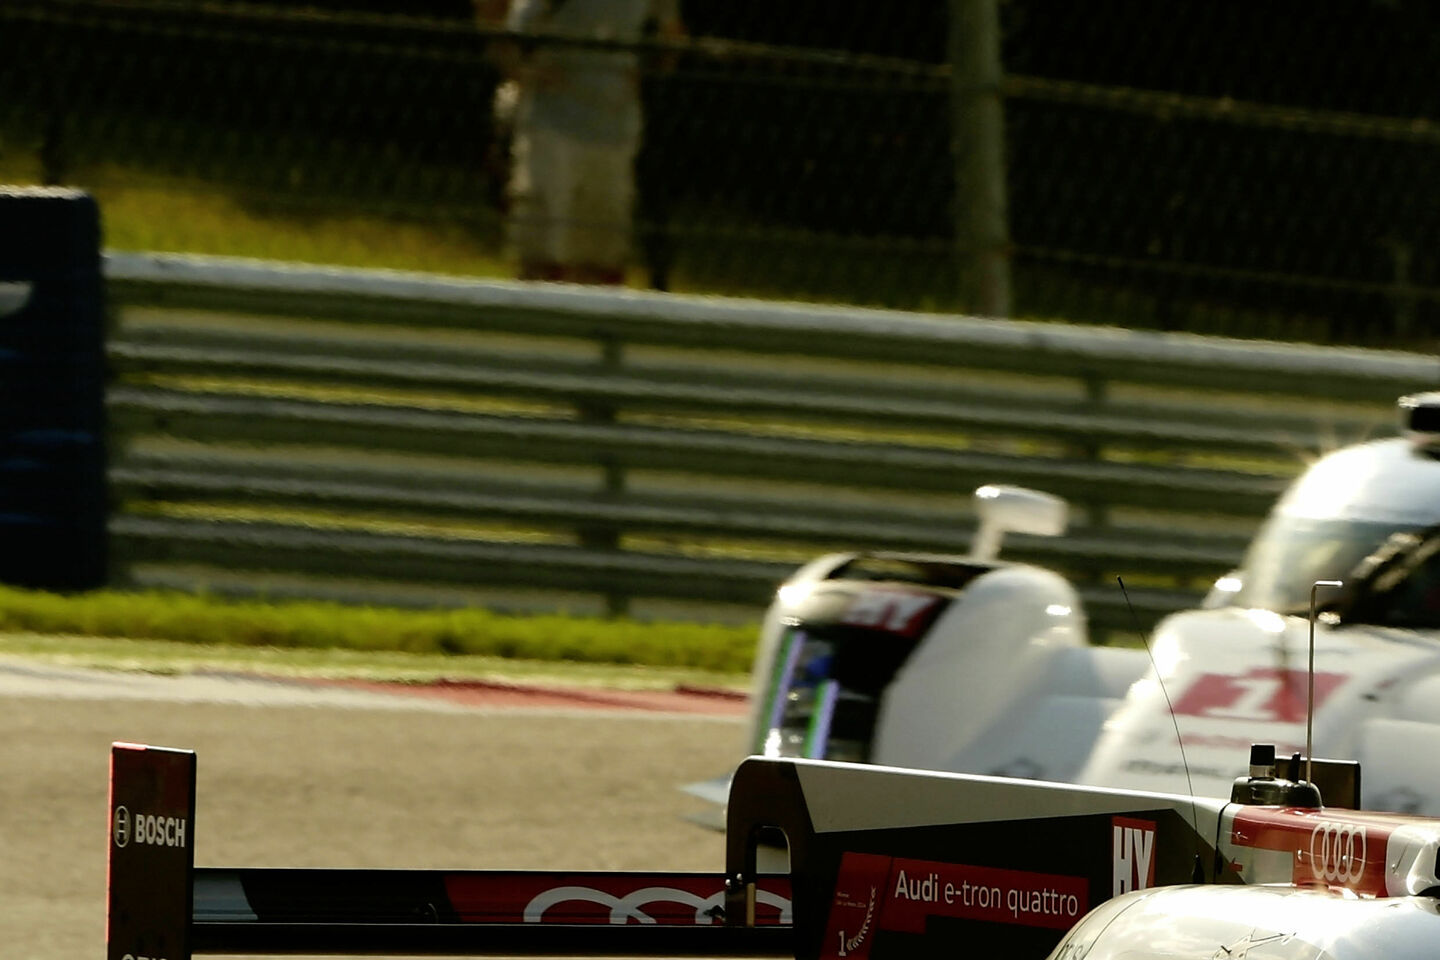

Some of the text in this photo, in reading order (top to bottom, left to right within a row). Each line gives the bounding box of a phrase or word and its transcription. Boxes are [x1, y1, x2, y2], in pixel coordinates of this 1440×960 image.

[135, 813, 186, 848] BOSCH
[1113, 825, 1155, 898] HY
[895, 869, 938, 903] Audi
[944, 879, 1001, 909] e-tron
[1007, 887, 1079, 919] quattro
